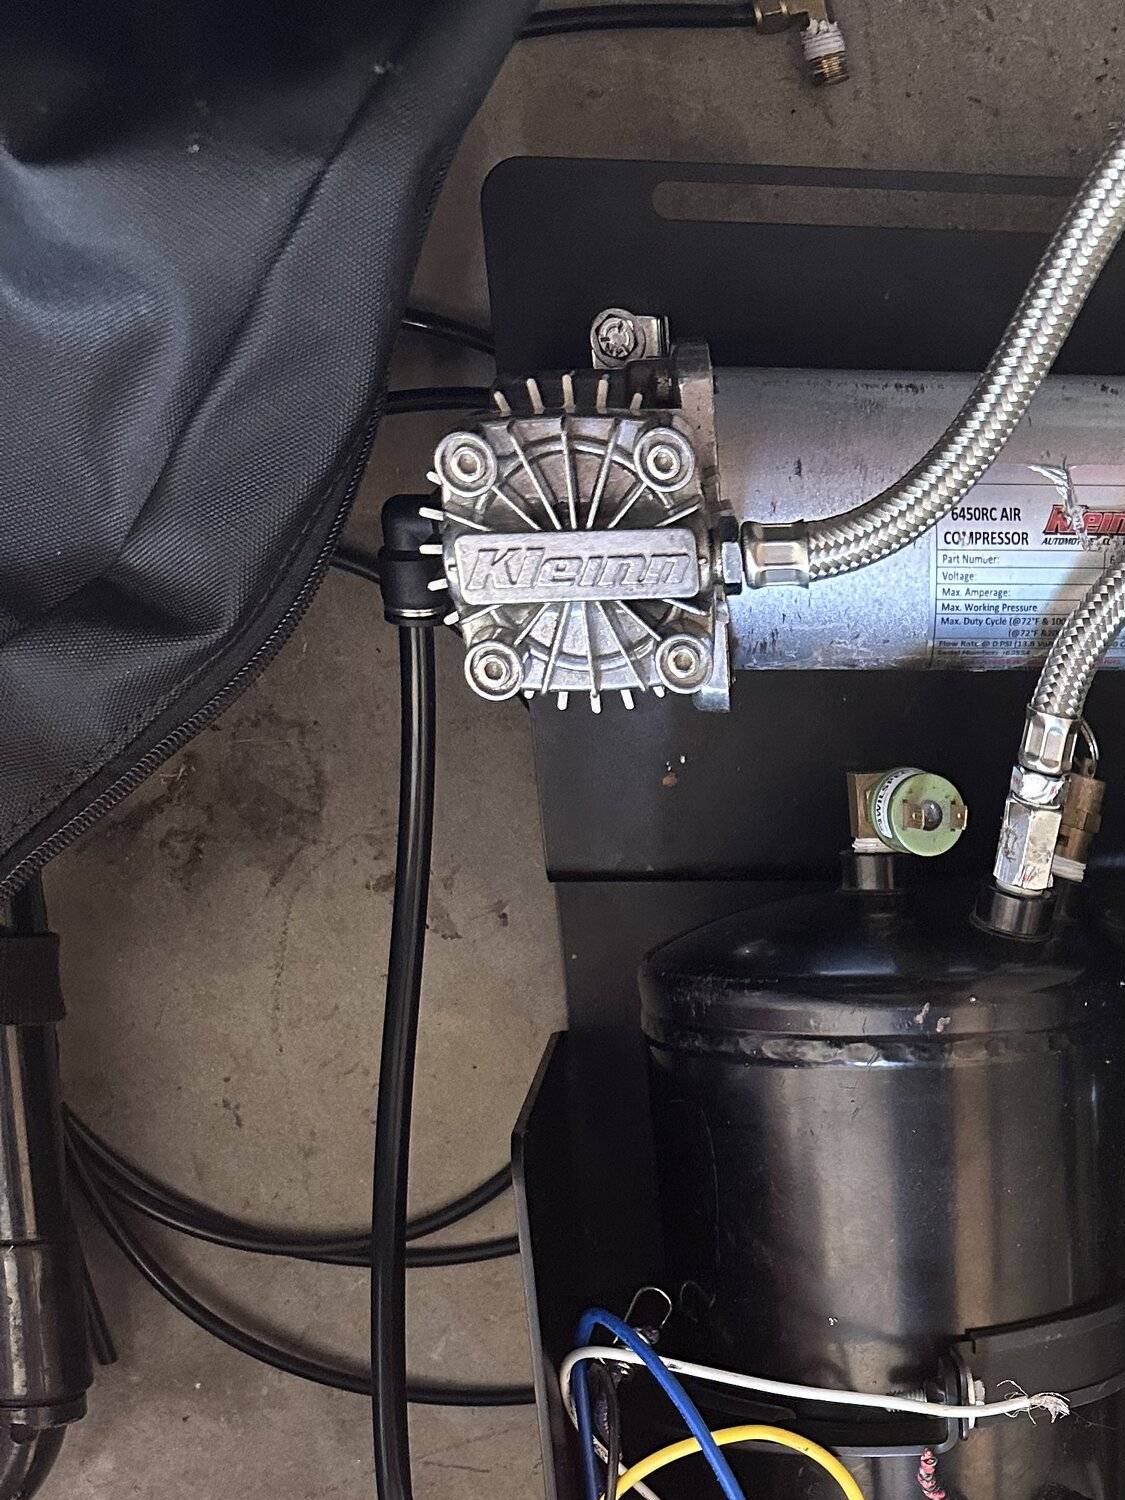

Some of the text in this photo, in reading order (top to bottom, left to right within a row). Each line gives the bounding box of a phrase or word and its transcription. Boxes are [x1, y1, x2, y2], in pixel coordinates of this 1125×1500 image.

[951, 507, 1022, 521] 6450RC AIR
[944, 531, 1030, 546] COMPRESSOR
[942, 554, 960, 564] Part
[466, 546, 692, 591] Kleinn
[964, 588, 1011, 599] Amperage:
[941, 604, 961, 612] Max.
[964, 604, 1000, 614] Working
[941, 618, 960, 626] Max.
[963, 618, 983, 627] Duty
[985, 617, 1007, 627] Cycle
